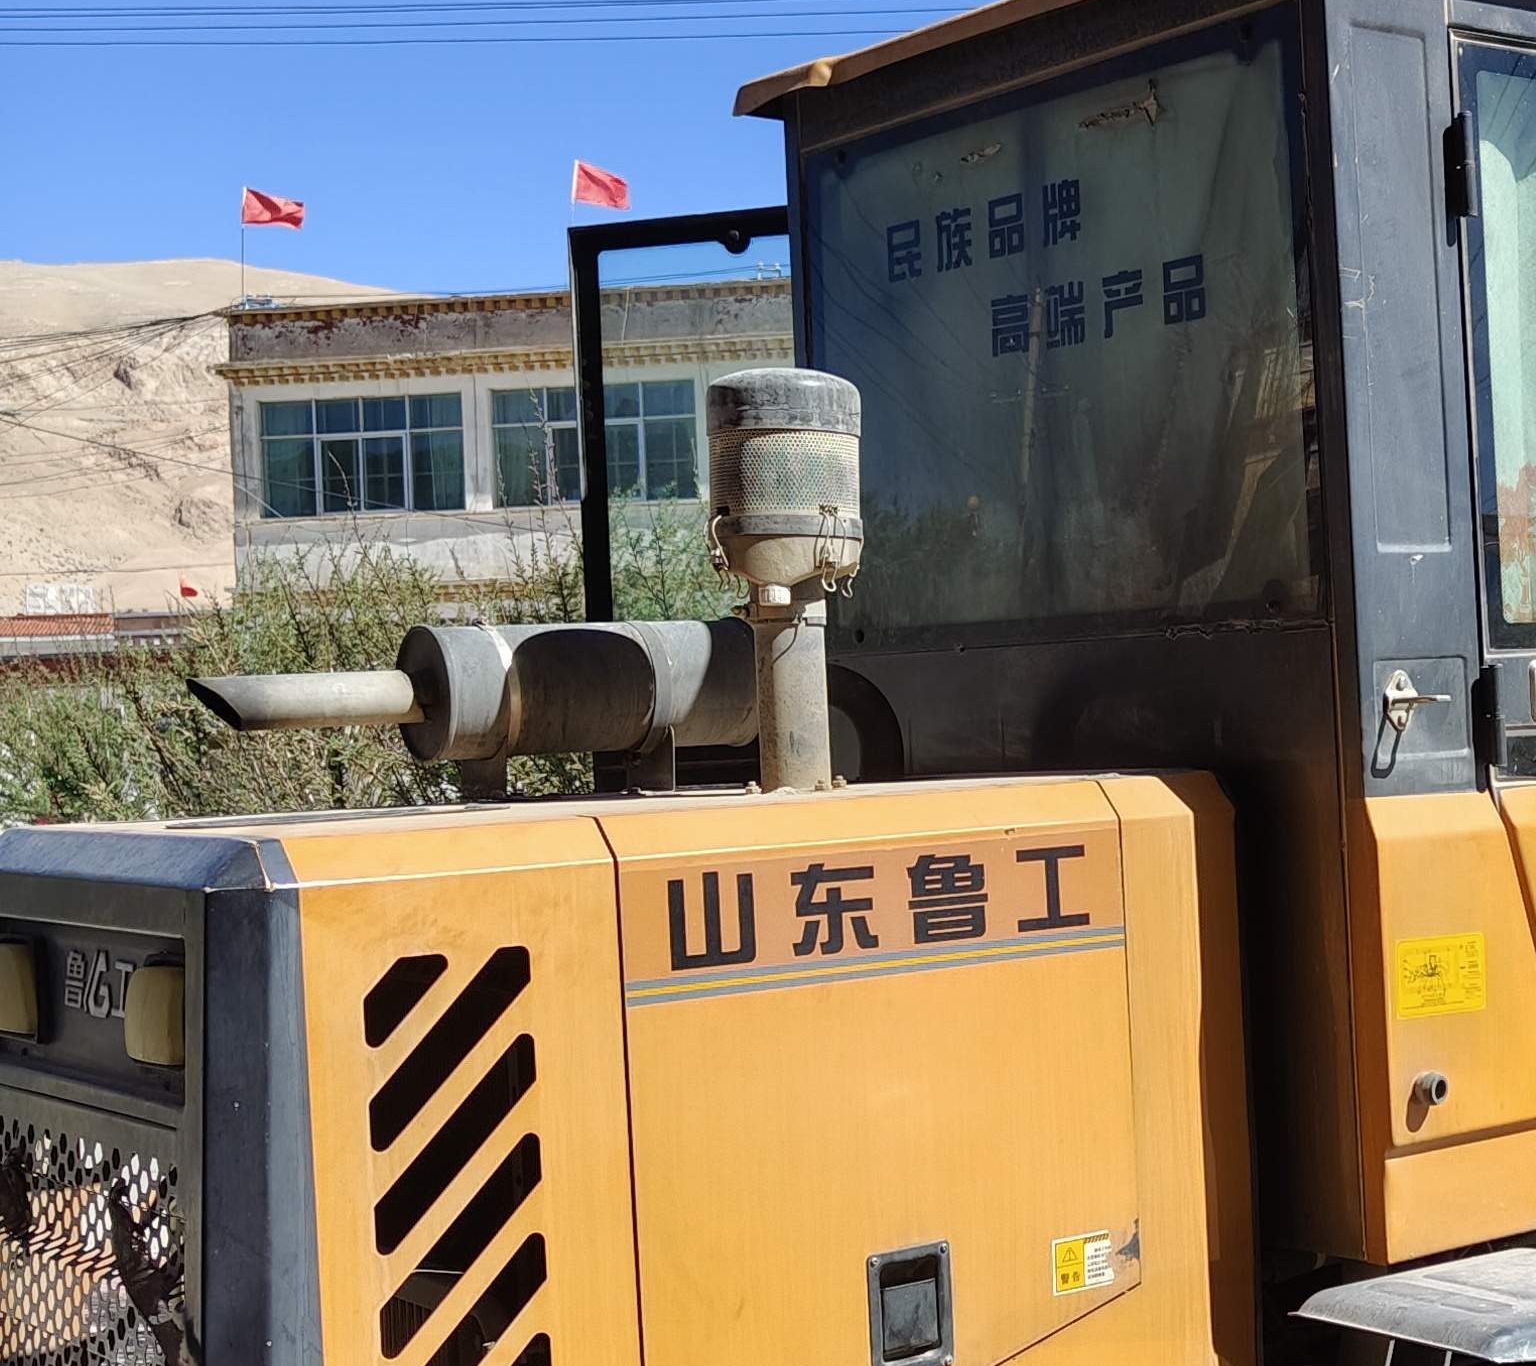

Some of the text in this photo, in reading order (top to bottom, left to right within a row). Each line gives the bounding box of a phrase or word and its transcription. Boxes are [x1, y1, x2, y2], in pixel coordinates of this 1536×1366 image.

[886, 178, 1081, 283] 民族品牌
[990, 254, 1207, 358] 高端产品
[666, 843, 1092, 972] 山东鲁工
